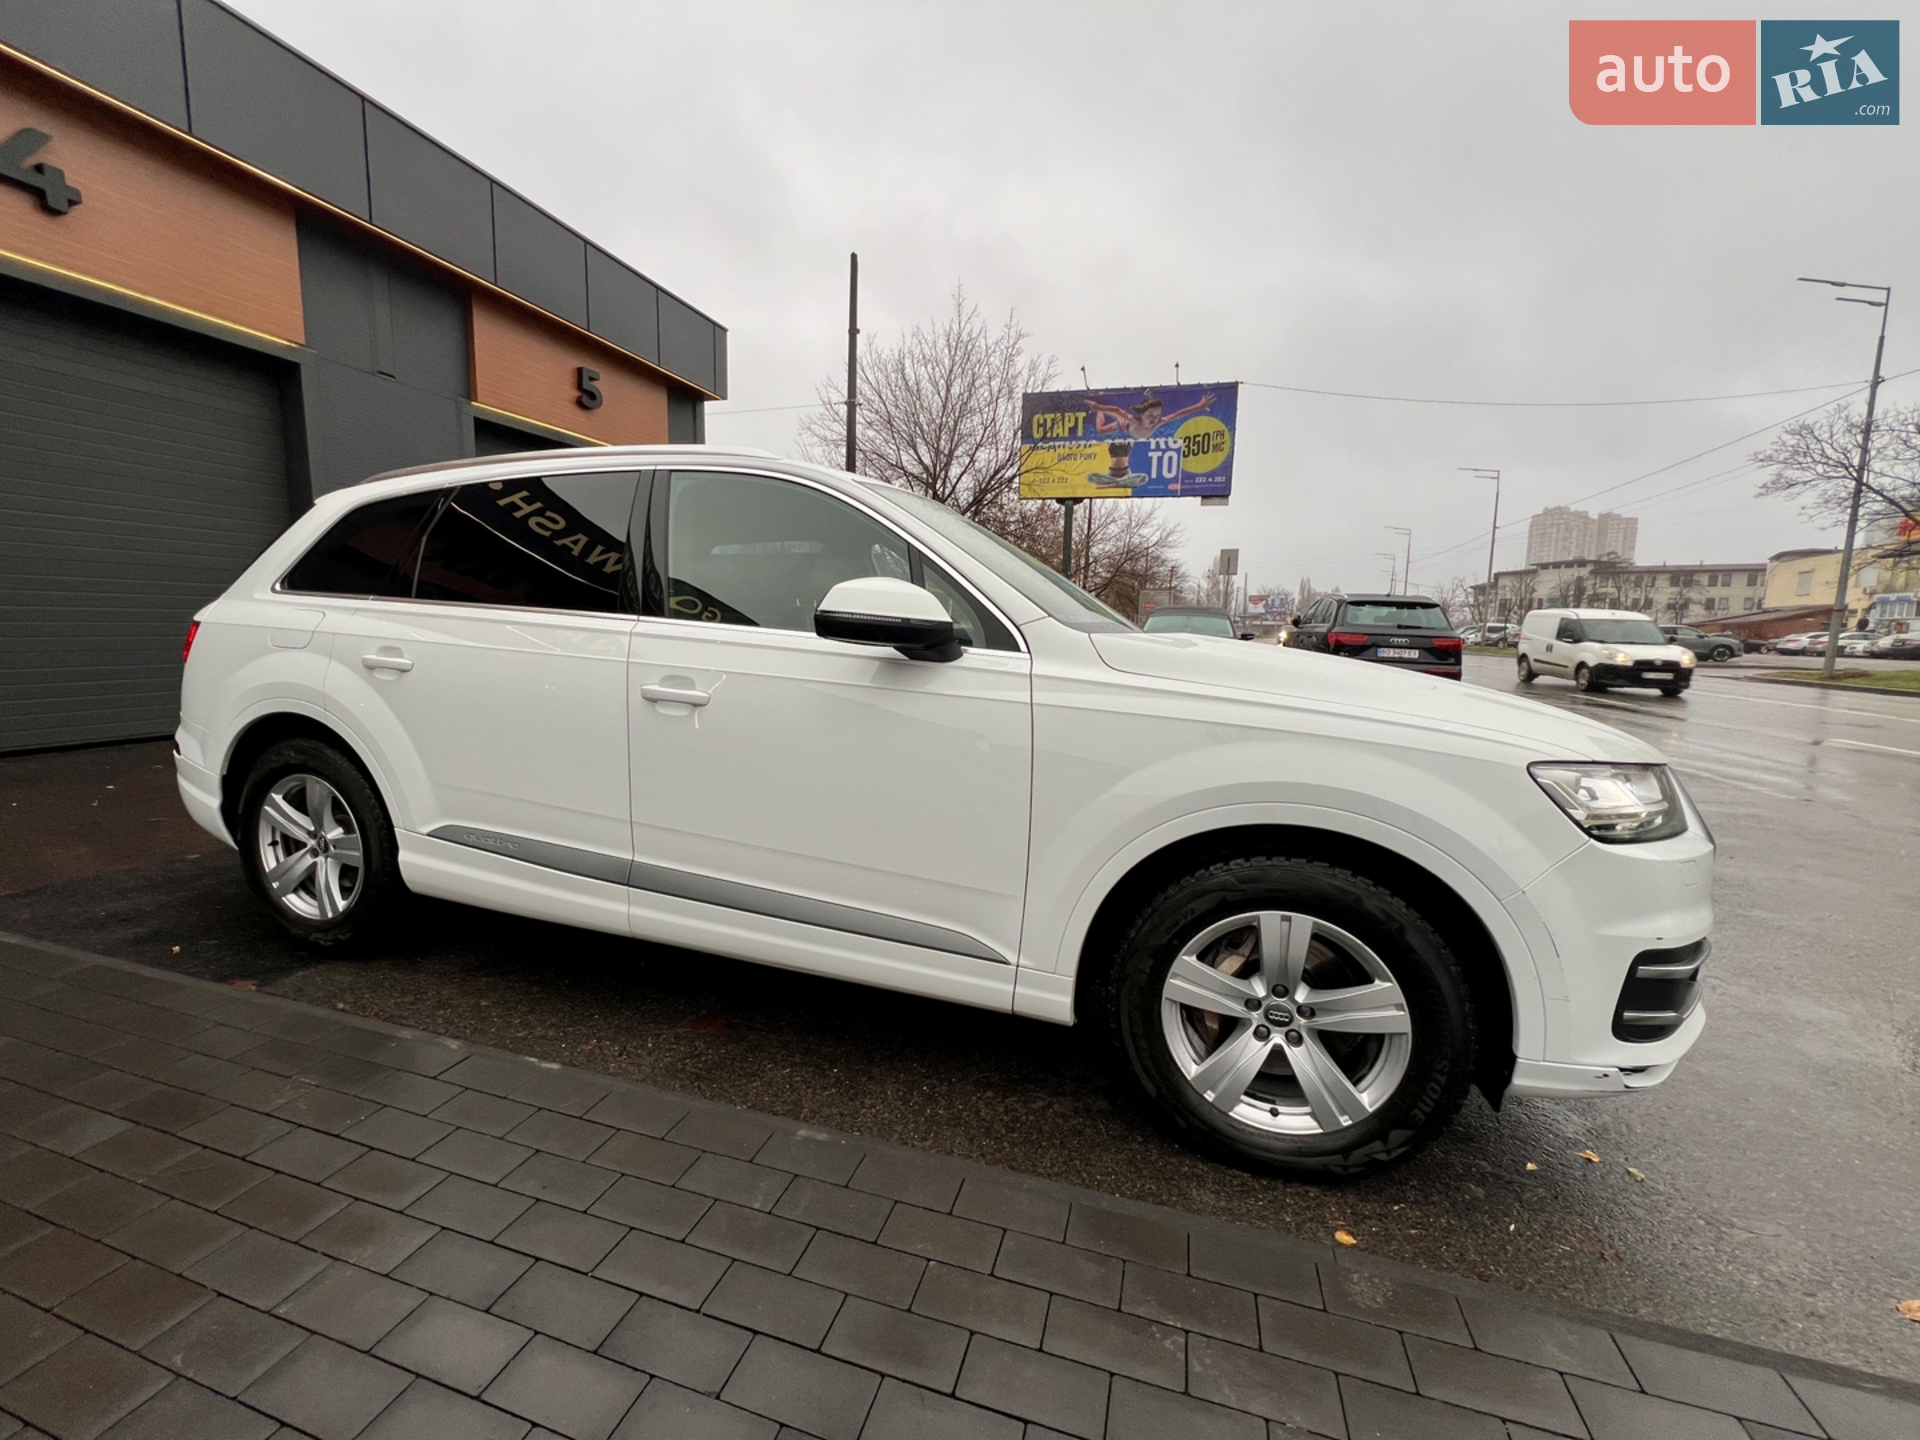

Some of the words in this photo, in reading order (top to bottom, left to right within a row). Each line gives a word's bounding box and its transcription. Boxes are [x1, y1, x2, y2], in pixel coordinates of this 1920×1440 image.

[0, 127, 83, 216] 4
[576, 366, 604, 410] 5
[1032, 411, 1087, 439] СТАРТ
[1182, 432, 1211, 459] 350
